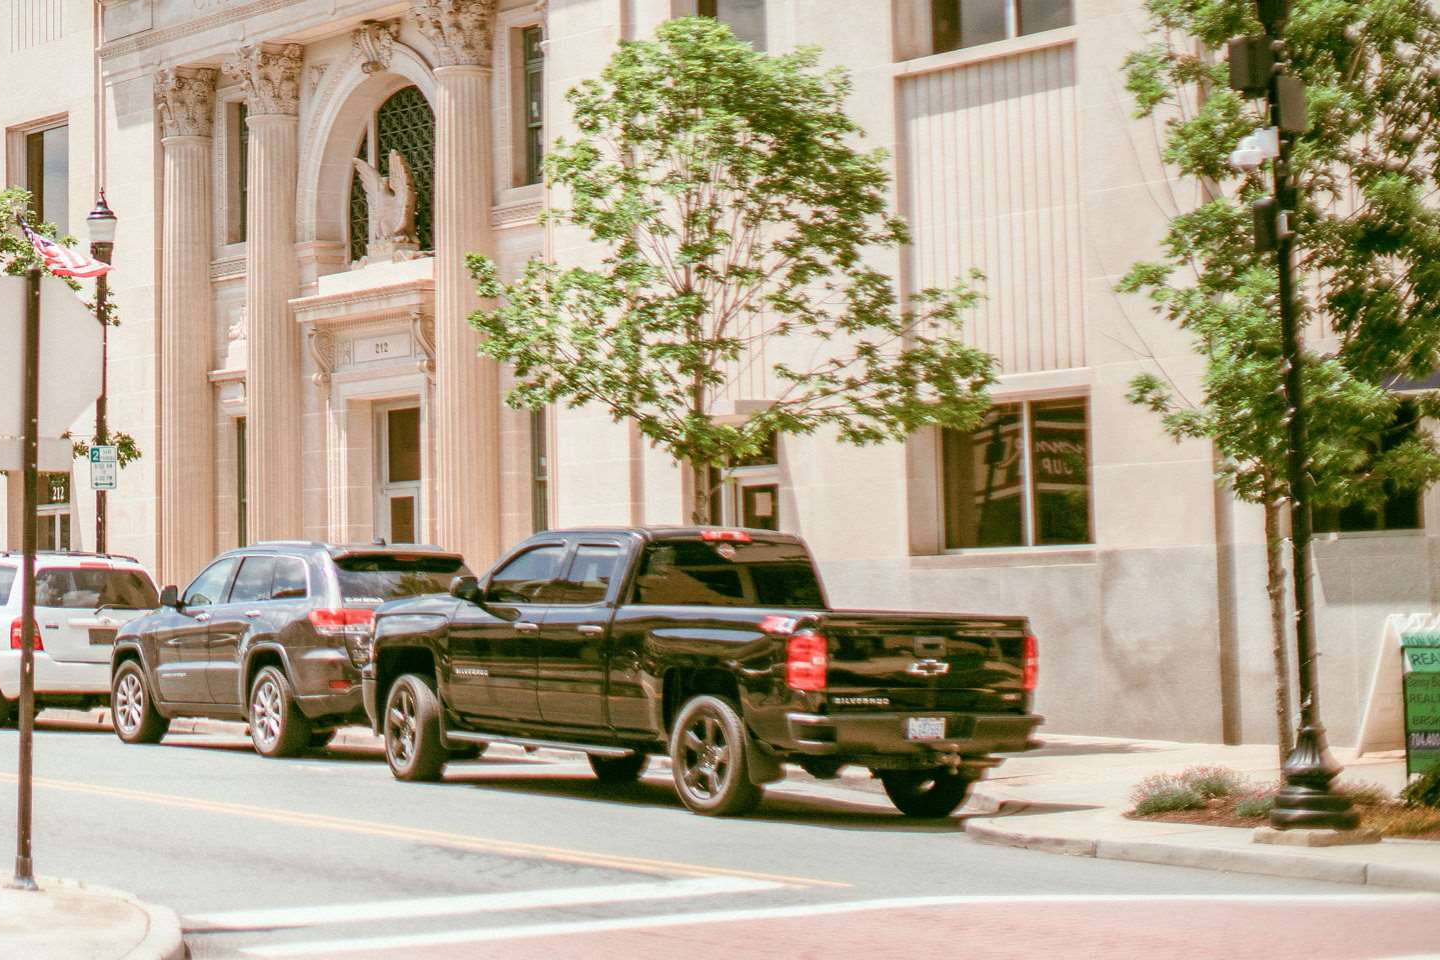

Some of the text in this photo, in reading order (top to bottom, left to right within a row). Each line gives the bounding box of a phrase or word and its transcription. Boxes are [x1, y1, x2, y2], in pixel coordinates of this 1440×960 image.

[375, 342, 389, 354] 212
[92, 450, 99, 461] 2
[52, 486, 64, 500] 212
